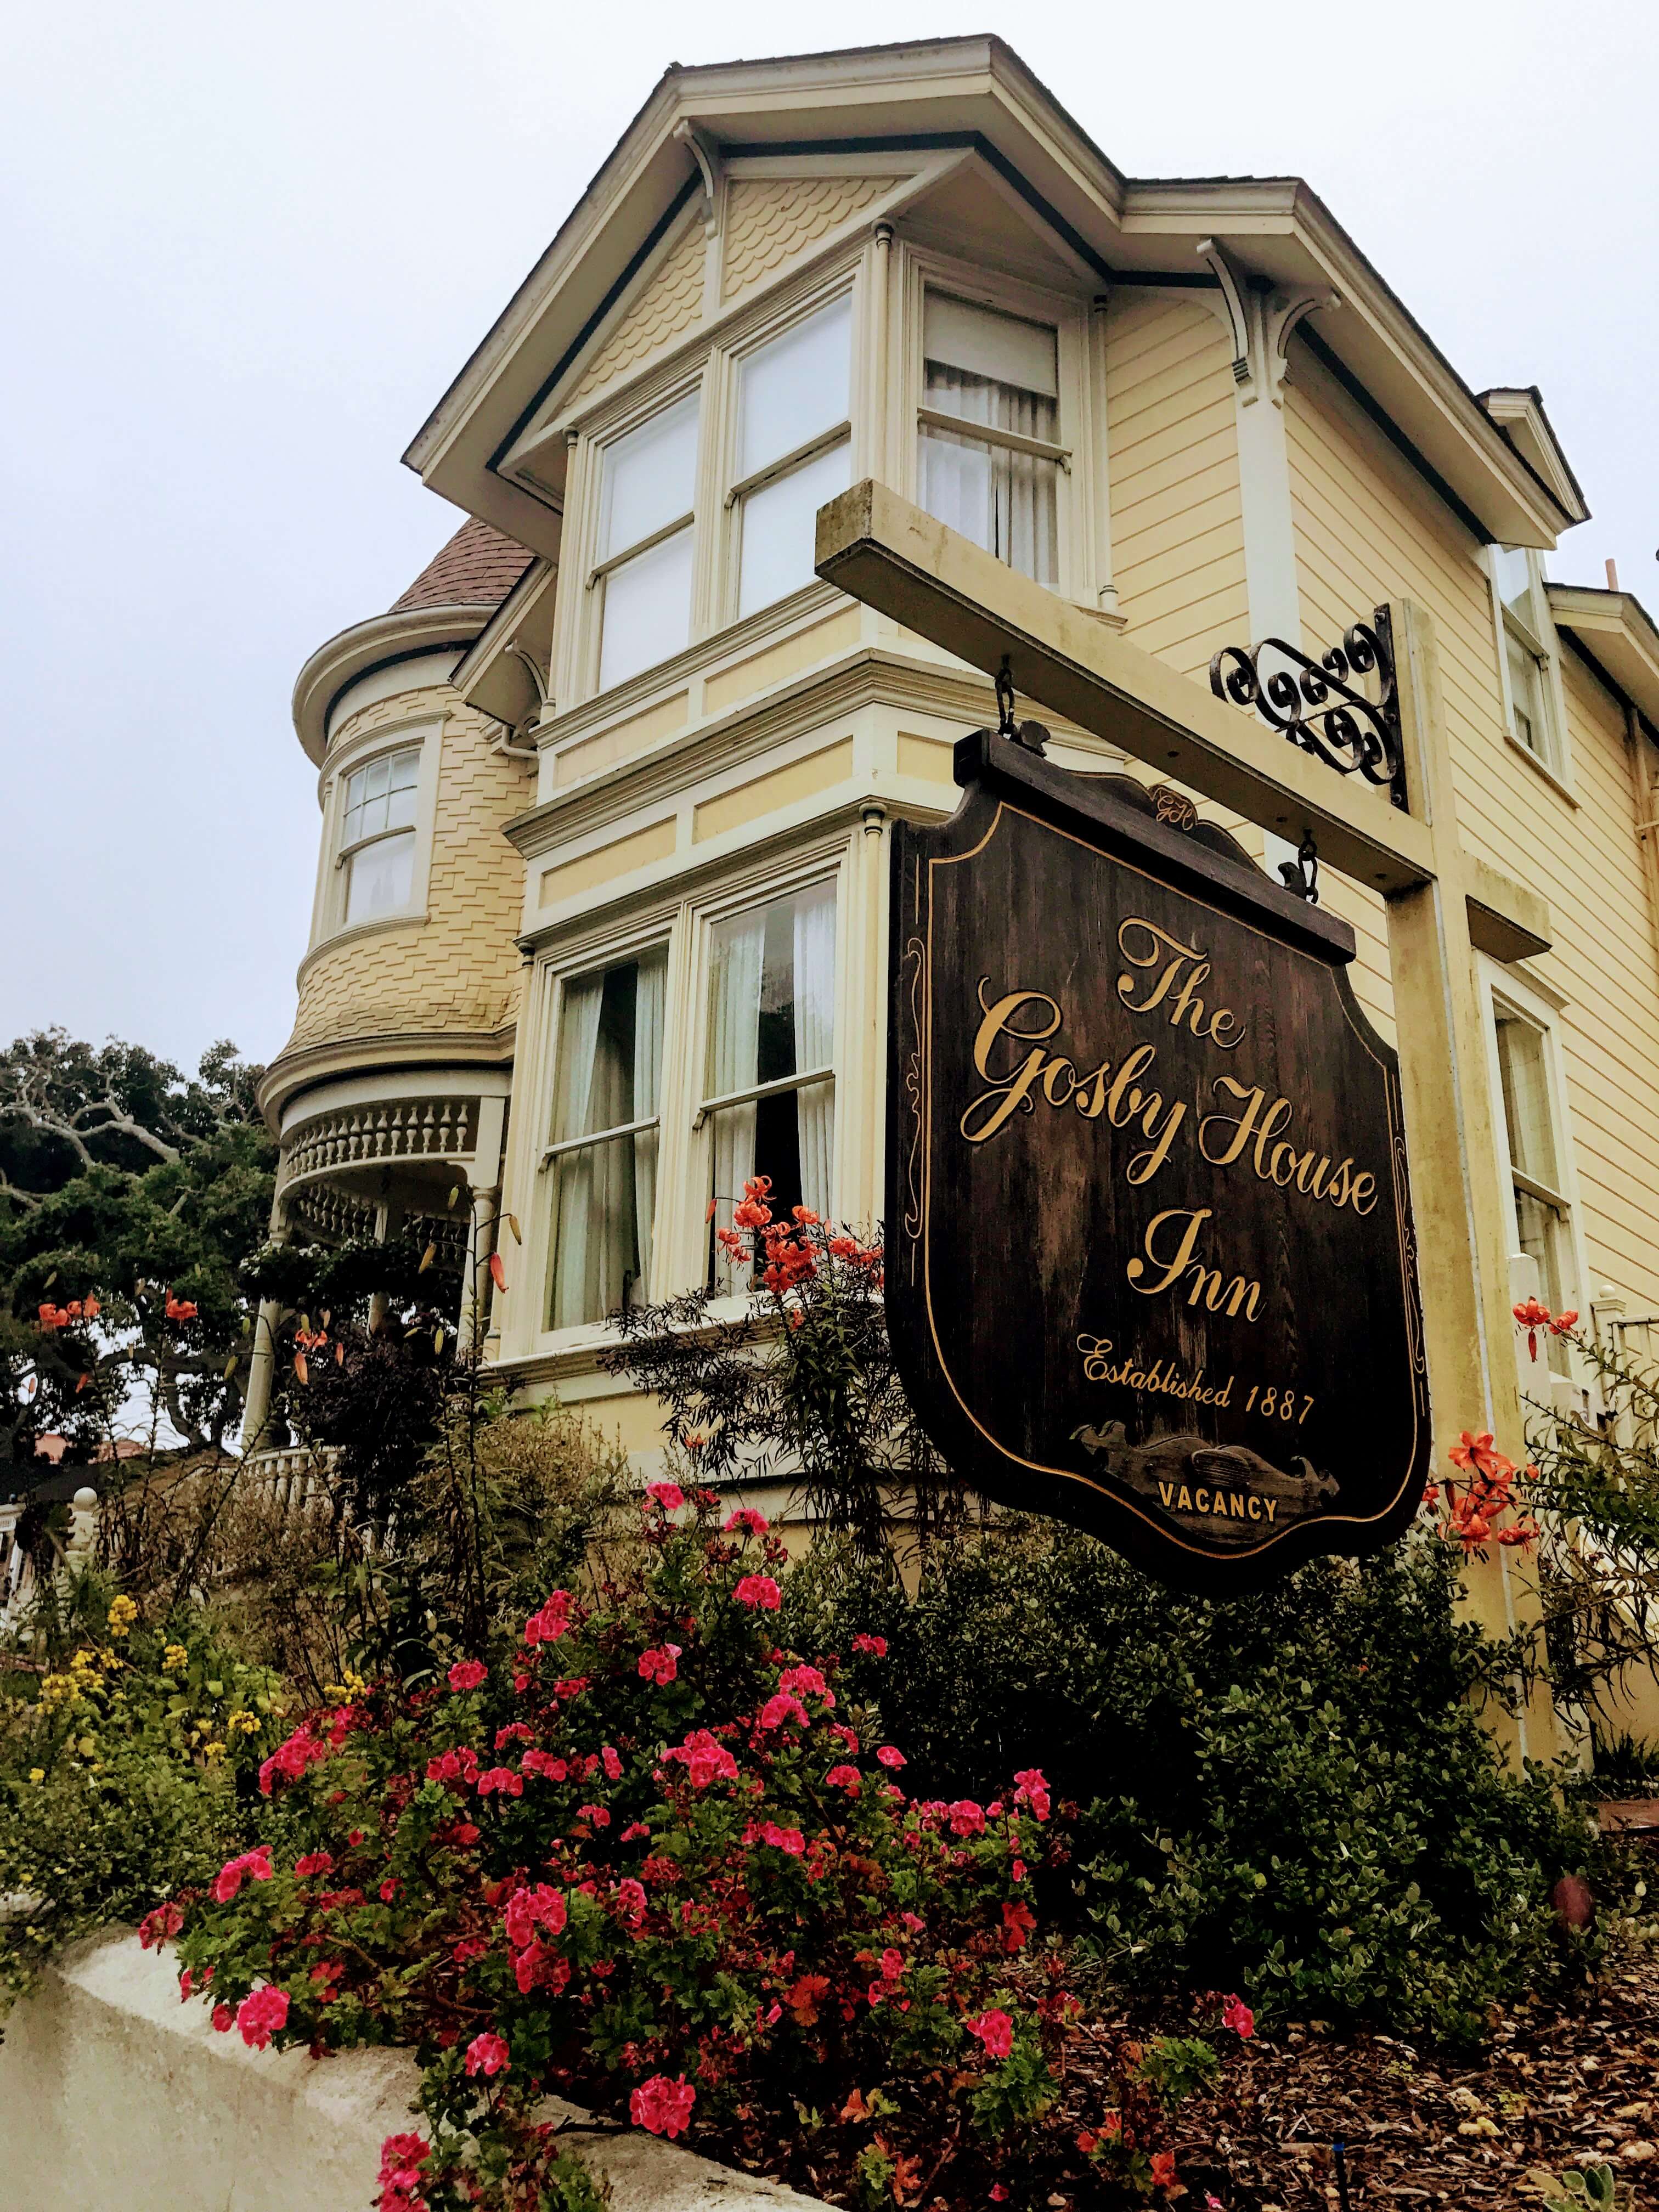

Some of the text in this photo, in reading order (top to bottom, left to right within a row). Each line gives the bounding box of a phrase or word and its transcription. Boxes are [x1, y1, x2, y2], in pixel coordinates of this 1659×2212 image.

[1117, 916, 1245, 1048] The
[961, 976, 1378, 1215] Gosby House
[1126, 1208, 1267, 1322] Inn
[1076, 1333, 1314, 1424] Established 1887
[1158, 1481, 1280, 1522] VACANCY
